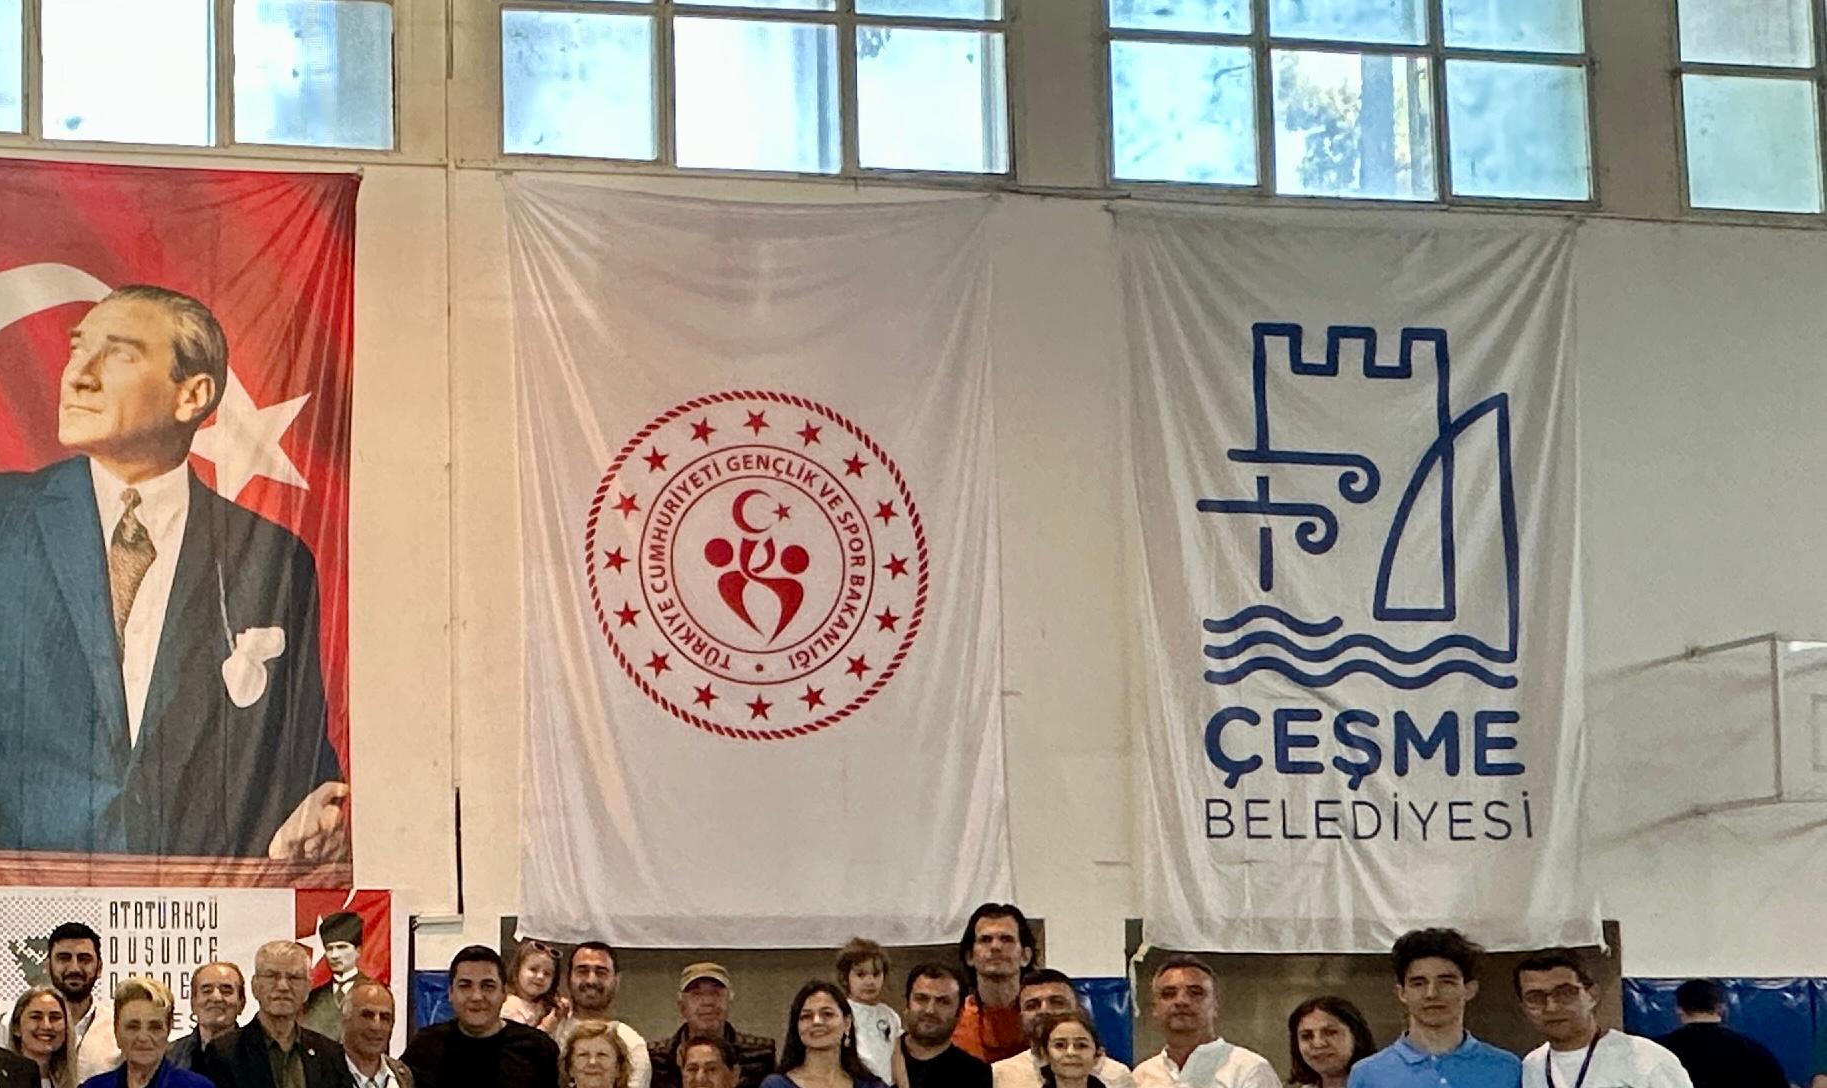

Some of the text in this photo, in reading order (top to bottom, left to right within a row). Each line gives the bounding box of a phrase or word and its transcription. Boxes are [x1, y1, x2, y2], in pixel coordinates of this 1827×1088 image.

[649, 454, 866, 670] TÜRKİYE CUMHURİYETİ GENÇLİK VE SPOR BAKANLIĞI
[1204, 706, 1525, 791] ÇEŞME
[1205, 790, 1533, 841] BELEDİYESİ
[109, 896, 218, 931] ATATÜRKÇÜ
[109, 931, 218, 966] DÜŞÜNCE
